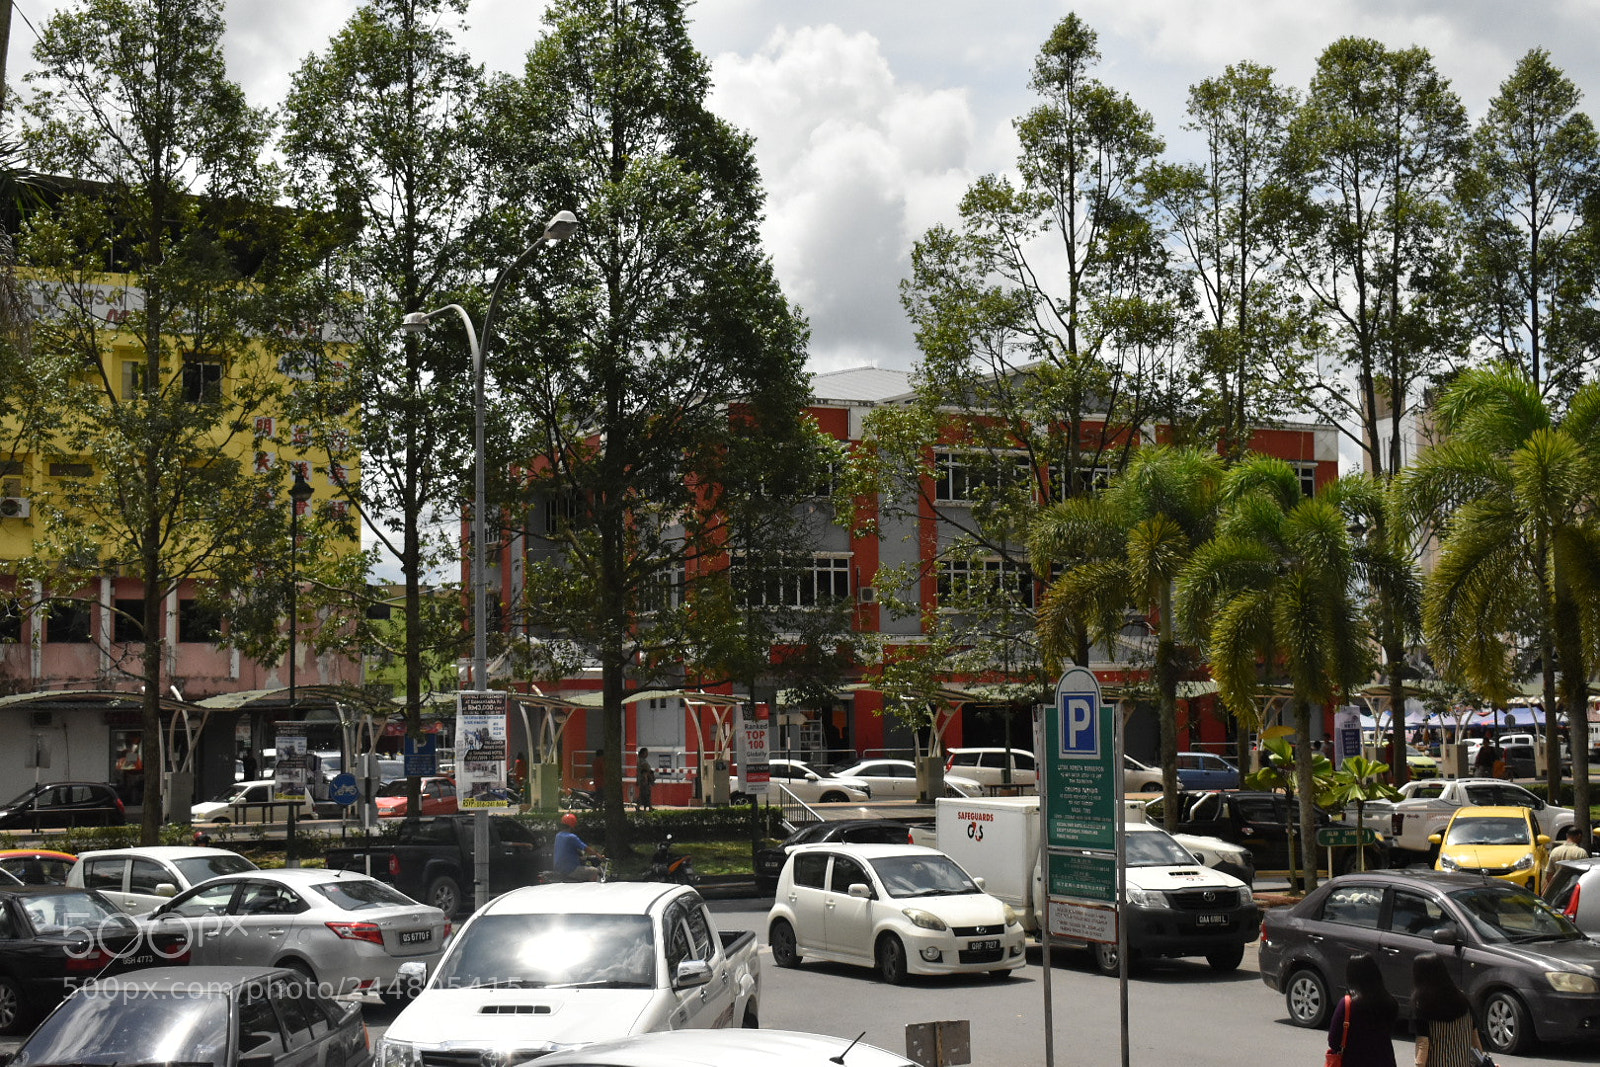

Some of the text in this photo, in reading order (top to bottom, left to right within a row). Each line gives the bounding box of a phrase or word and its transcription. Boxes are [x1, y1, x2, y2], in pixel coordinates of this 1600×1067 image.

[1068, 699, 1091, 748] P
[746, 730, 765, 740] TOP
[748, 740, 764, 749] 100
[957, 811, 994, 822] SAFEGUARDS
[411, 931, 425, 941] 6770
[137, 955, 153, 963] 4773
